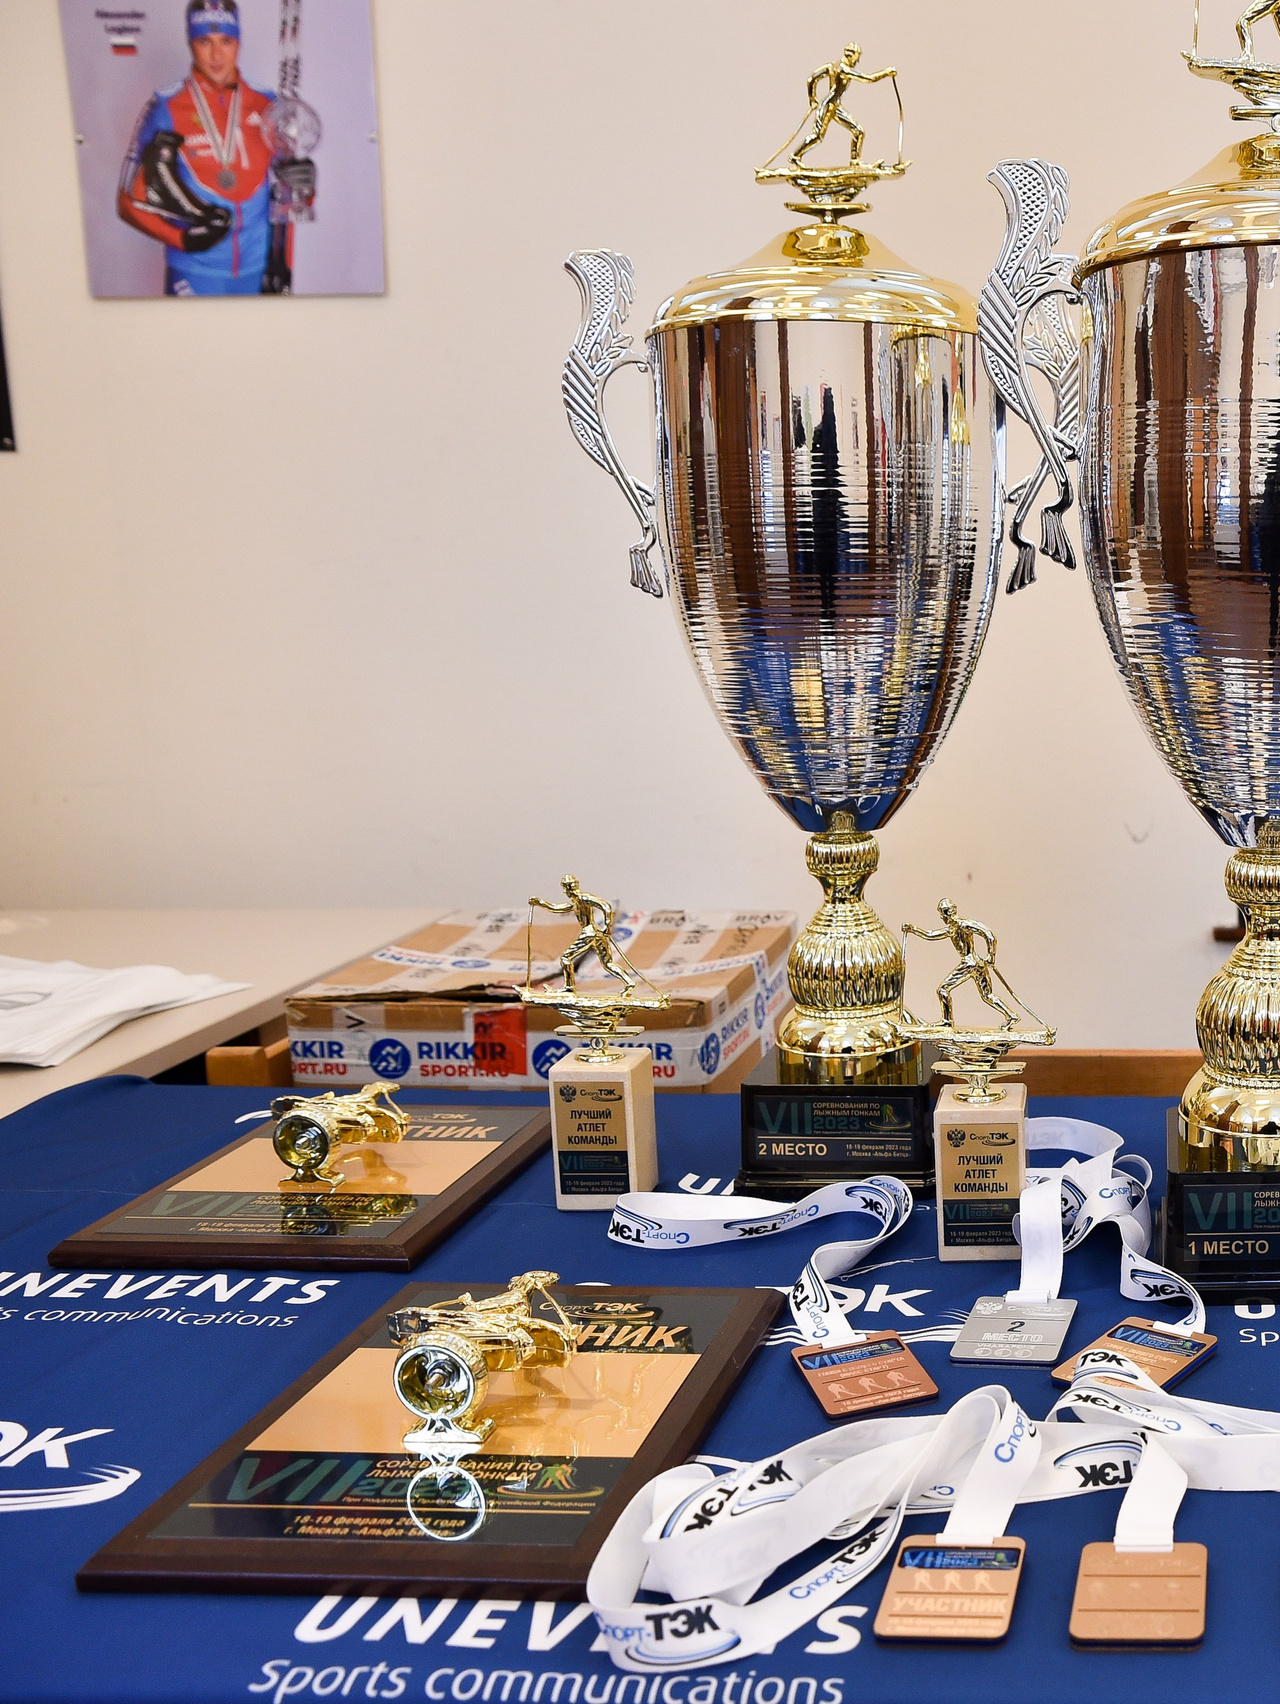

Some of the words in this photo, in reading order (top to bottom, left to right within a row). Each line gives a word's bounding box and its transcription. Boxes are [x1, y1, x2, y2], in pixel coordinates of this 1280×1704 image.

[291, 1040, 345, 1059] KKIR
[418, 1041, 507, 1060] RIKKIR
[570, 1108, 612, 1119] ЛУЧШИЙ
[758, 1102, 812, 1134] VII
[577, 1123, 606, 1132] АТЛЕТ
[813, 1117, 859, 1130] 2023
[568, 1136, 617, 1146] КОМАНДЫ
[759, 1143, 767, 1155] 2
[772, 1143, 827, 1156] МЕСТО
[958, 1153, 1003, 1166] ЛУЧШИЙ
[965, 1169, 997, 1179] АТЛЕТ
[954, 1182, 1008, 1193] КОМАНДЫ
[1188, 1192, 1252, 1230] VII
[1188, 1241, 1196, 1255] 1
[1203, 1240, 1269, 1255] МЕСТО
[0, 1272, 341, 1304] NEVENTS
[24, 1306, 299, 1327] communications
[1007, 1321, 1025, 1332] 2
[982, 1333, 1044, 1342] МЕСТО
[1081, 1352, 1129, 1368] ТЭК
[517, 1462, 543, 1471] ПО
[226, 1457, 371, 1502] VII
[334, 1516, 395, 1527] февраля
[433, 1518, 466, 1527] года
[296, 1526, 349, 1536] Москва
[248, 1659, 412, 1704] Sports
[424, 1667, 844, 1704] communications
